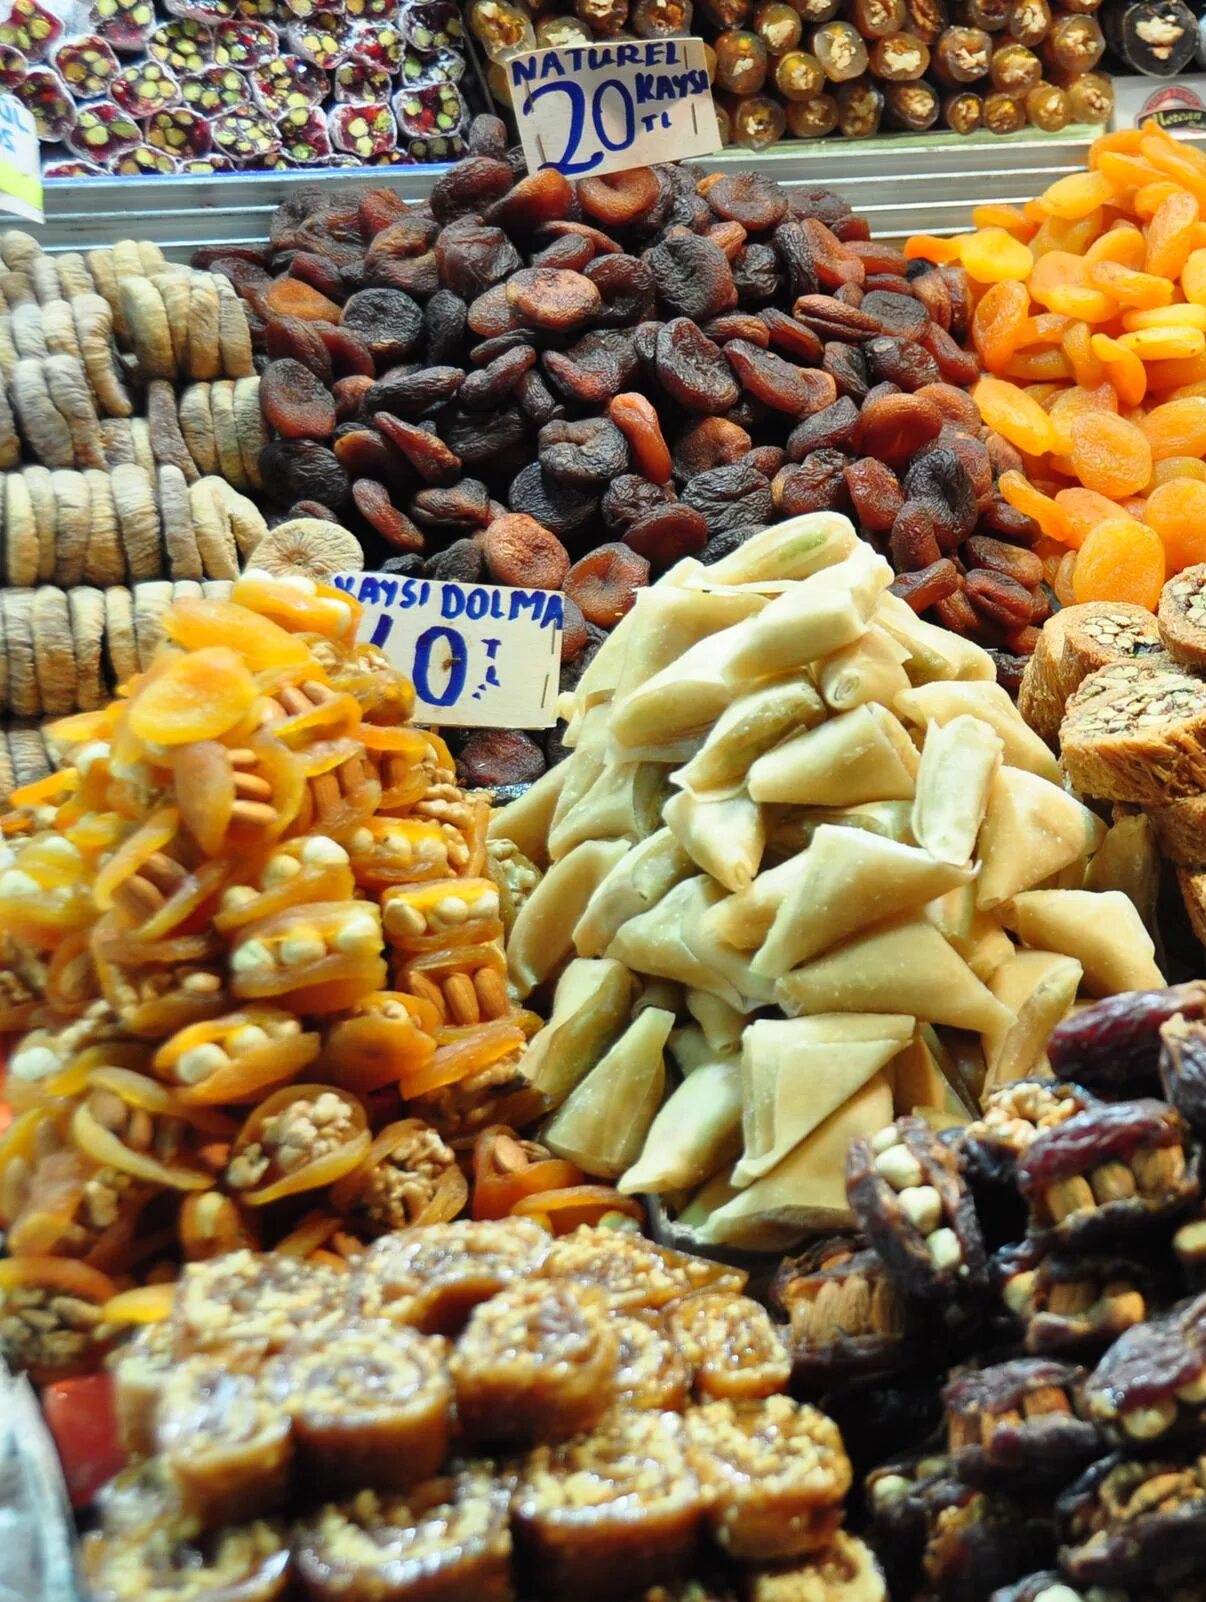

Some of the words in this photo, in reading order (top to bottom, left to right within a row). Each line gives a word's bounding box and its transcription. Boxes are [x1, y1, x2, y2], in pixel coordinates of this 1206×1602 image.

[512, 41, 681, 87] NATUREL
[635, 69, 710, 104] KAYSI
[523, 79, 635, 175] 20
[441, 584, 563, 630] DOLMA
